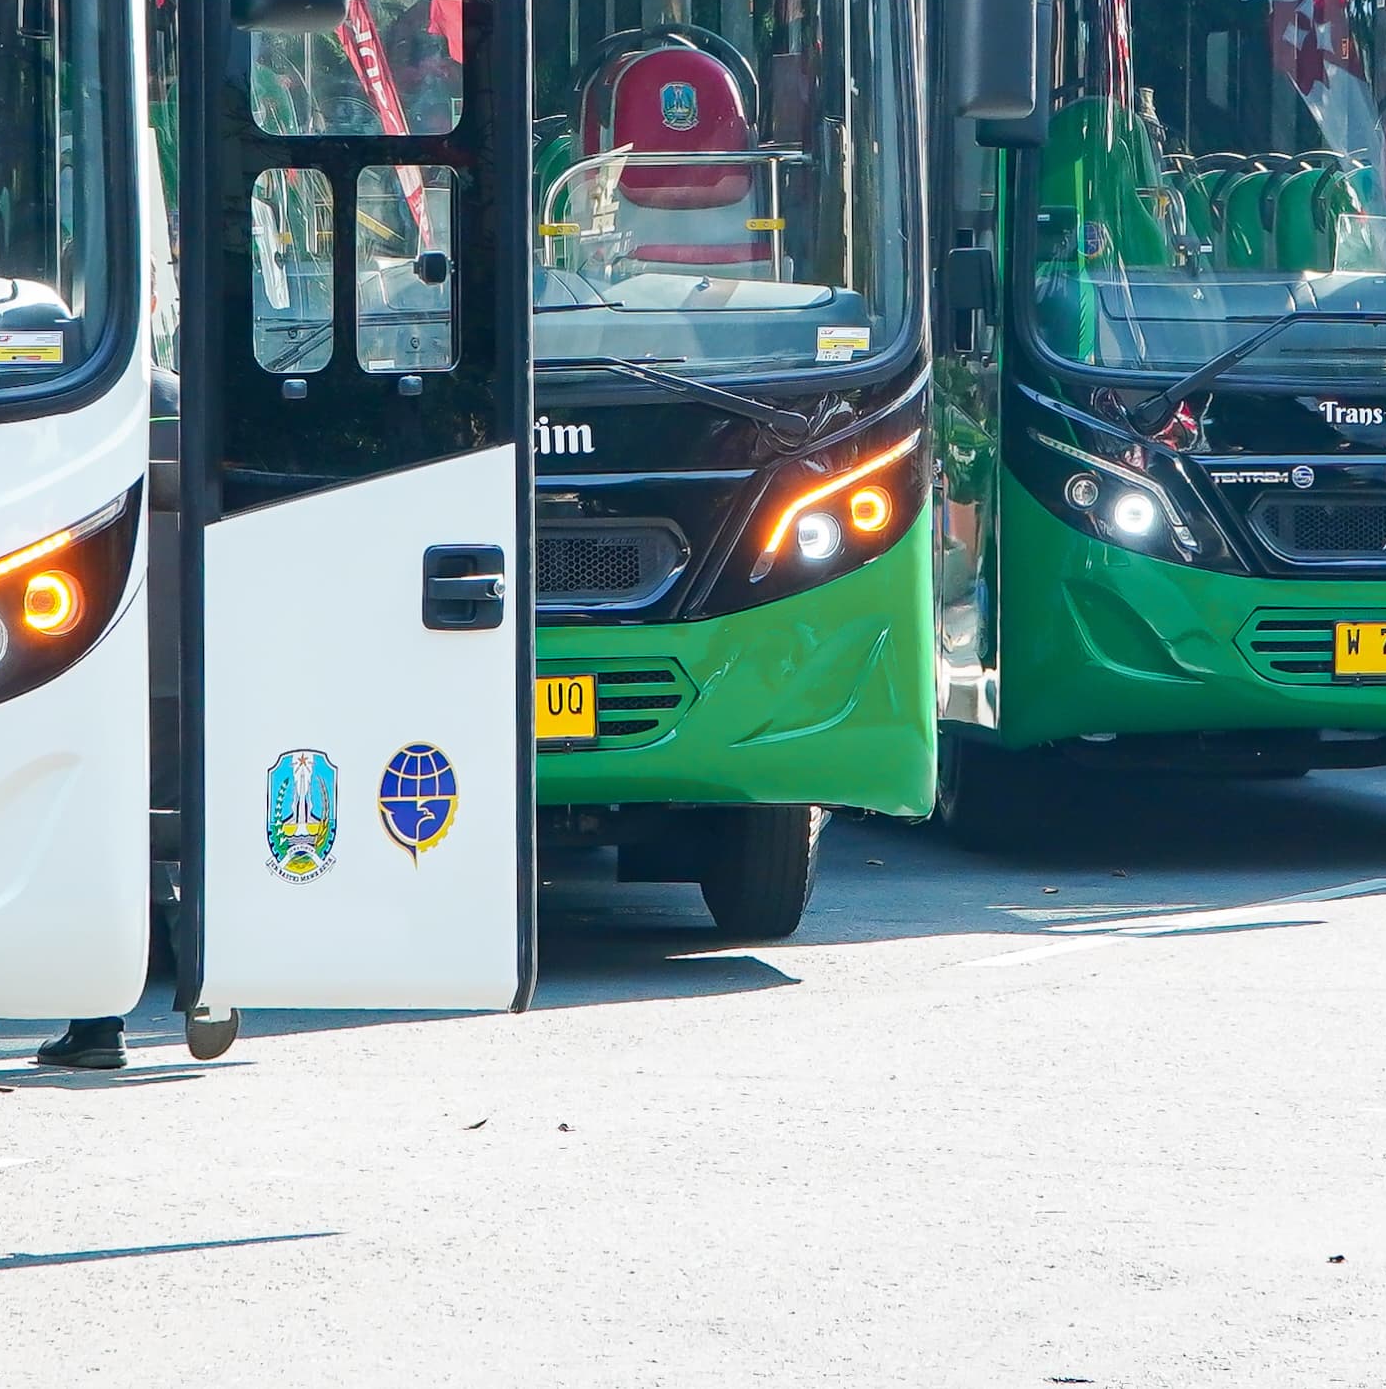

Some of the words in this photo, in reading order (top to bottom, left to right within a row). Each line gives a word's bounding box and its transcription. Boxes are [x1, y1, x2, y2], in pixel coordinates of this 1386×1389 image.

[1319, 401, 1383, 426] Trans
[1347, 628, 1361, 655] W
[547, 682, 584, 716] UQ
